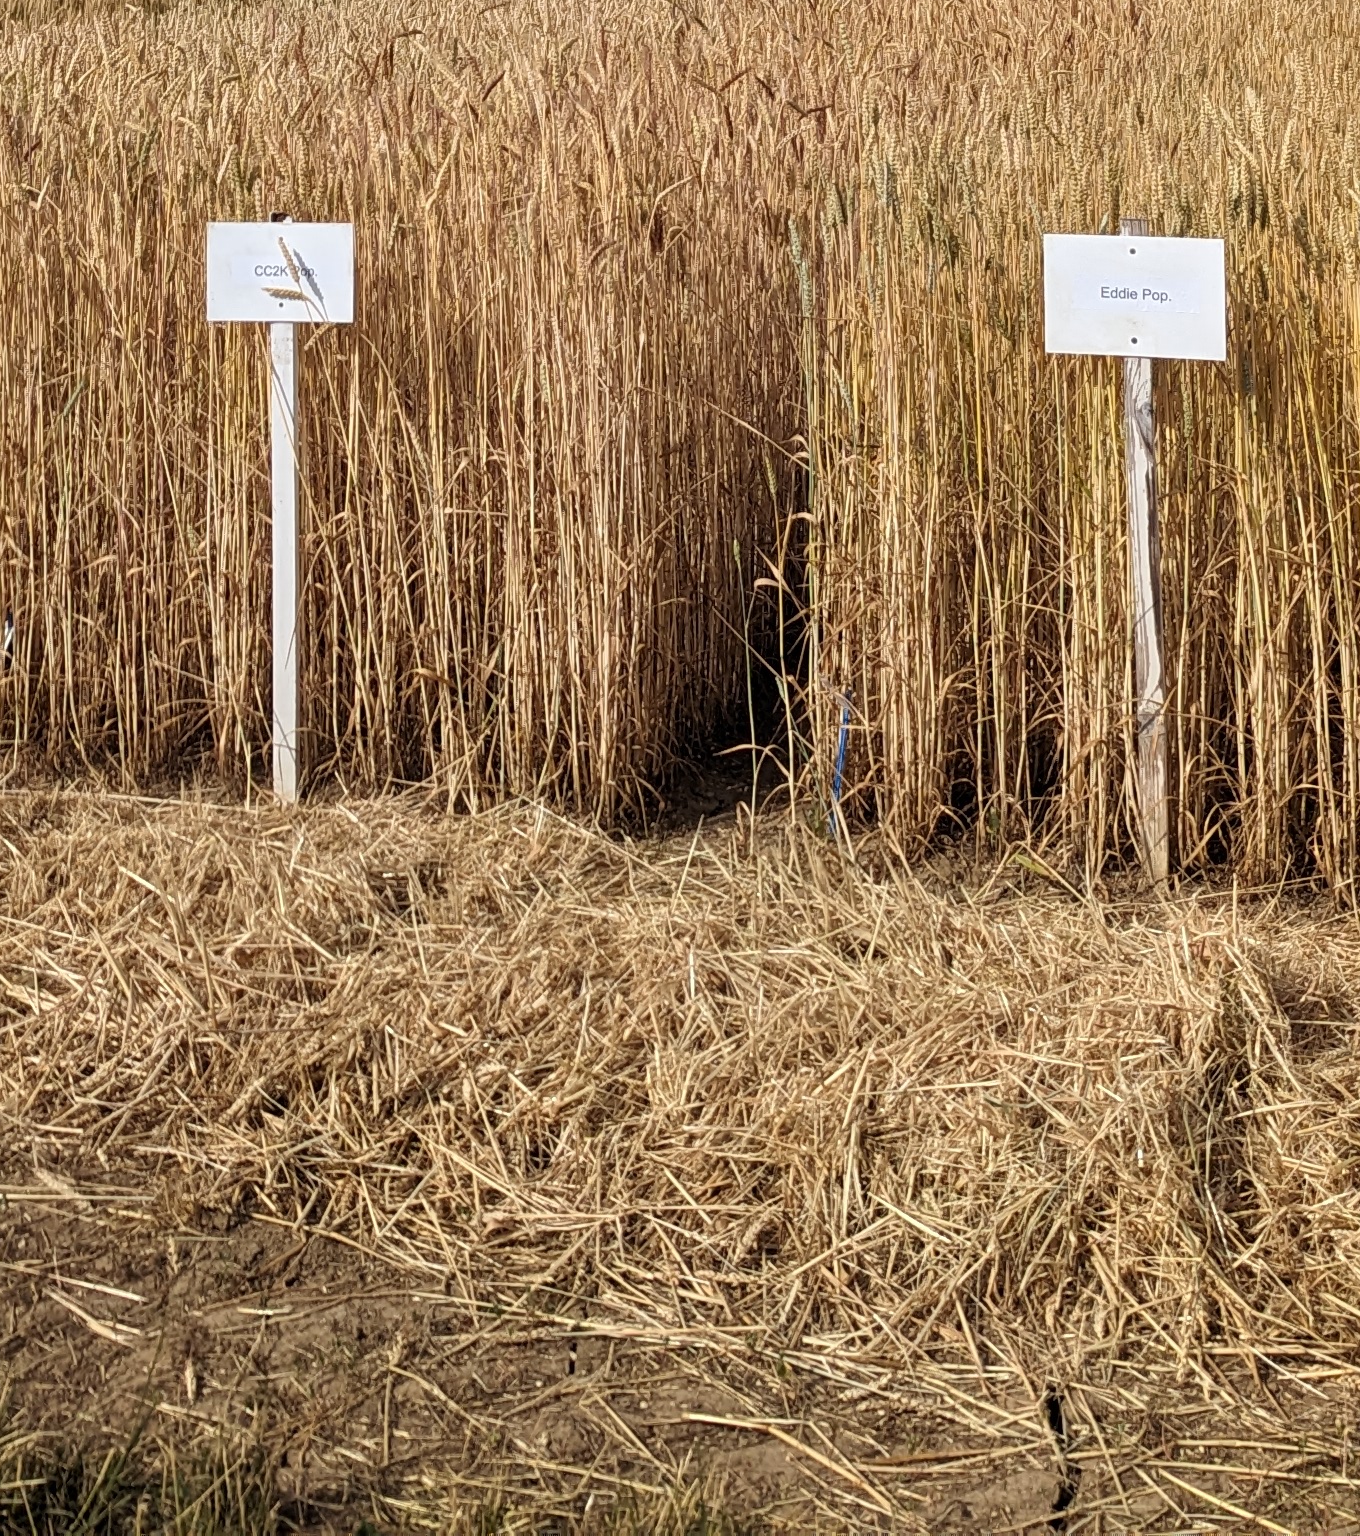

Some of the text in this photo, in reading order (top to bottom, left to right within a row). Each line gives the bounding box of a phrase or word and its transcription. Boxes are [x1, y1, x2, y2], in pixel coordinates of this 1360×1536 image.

[254, 265, 289, 278] CC2K
[1100, 286, 1172, 304] Eddie Pop.
